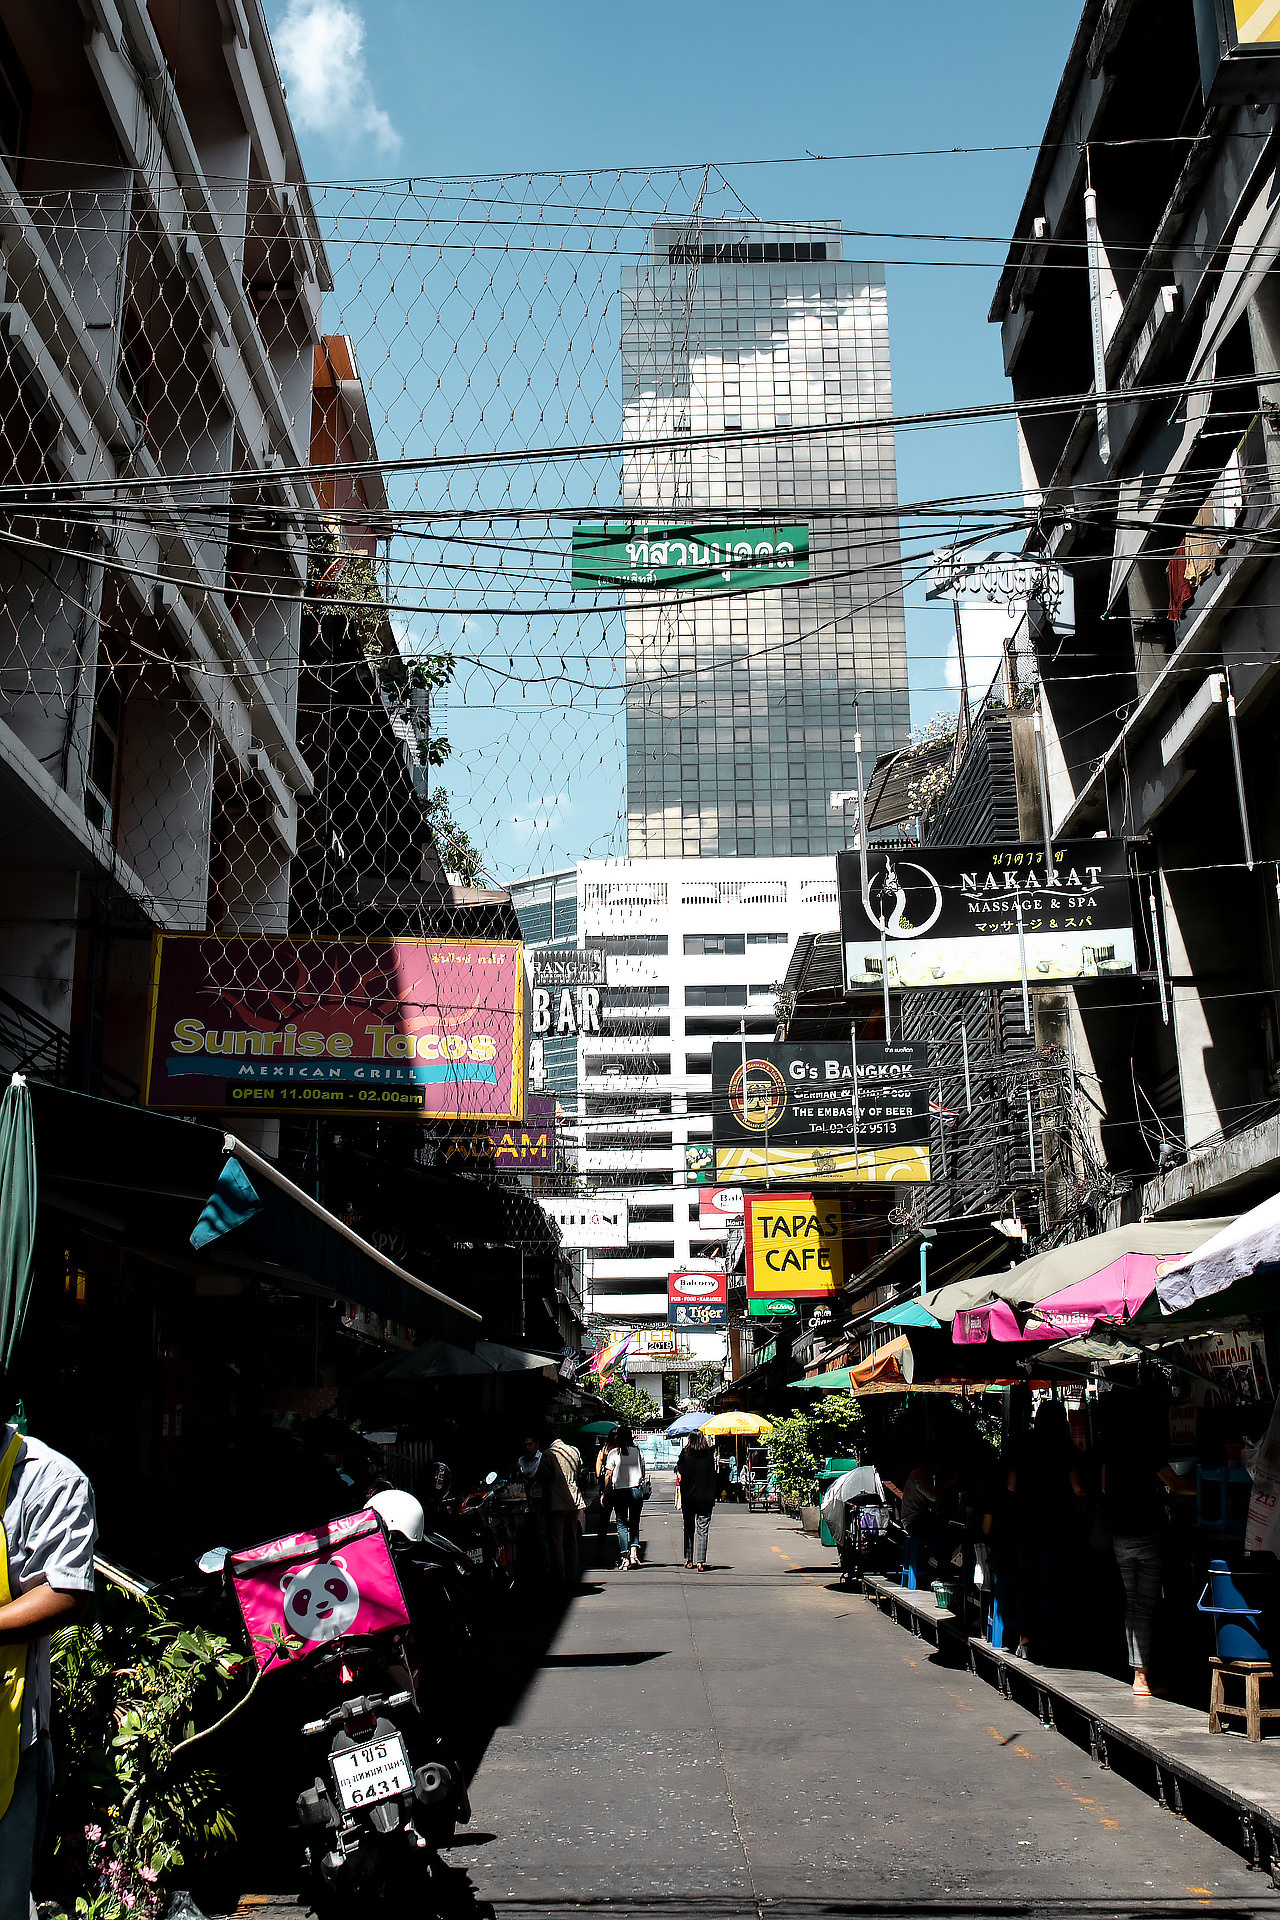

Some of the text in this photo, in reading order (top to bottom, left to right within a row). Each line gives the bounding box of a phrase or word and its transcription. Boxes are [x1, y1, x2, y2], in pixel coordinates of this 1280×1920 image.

[960, 866, 1101, 891] NAKARAT
[968, 896, 1098, 914] MASSAGE & SPA
[975, 917, 1043, 932] マッサージ
[1064, 915, 1093, 928] スパ
[532, 987, 601, 1033] BAR
[170, 1018, 497, 1061] Sunrise Tacos
[238, 1065, 418, 1080] MEXICAN GRILL
[528, 1038, 549, 1092] 4
[824, 1060, 913, 1079] BANGKOK
[232, 1088, 275, 1100] OPEN
[280, 1089, 344, 1101] 11.00am
[358, 1091, 423, 1104] 02.00am
[792, 1106, 913, 1117] THE EMBASY OF BEER
[869, 1123, 897, 1134] 9513
[446, 1133, 547, 1158] ADAM
[757, 1213, 839, 1238] TAPAS
[371, 1230, 399, 1251] SPY
[765, 1247, 832, 1272] CAFE
[688, 1305, 724, 1323] Tiger
[1255, 1490, 1277, 1508] 213
[351, 1775, 401, 1804] 6431
